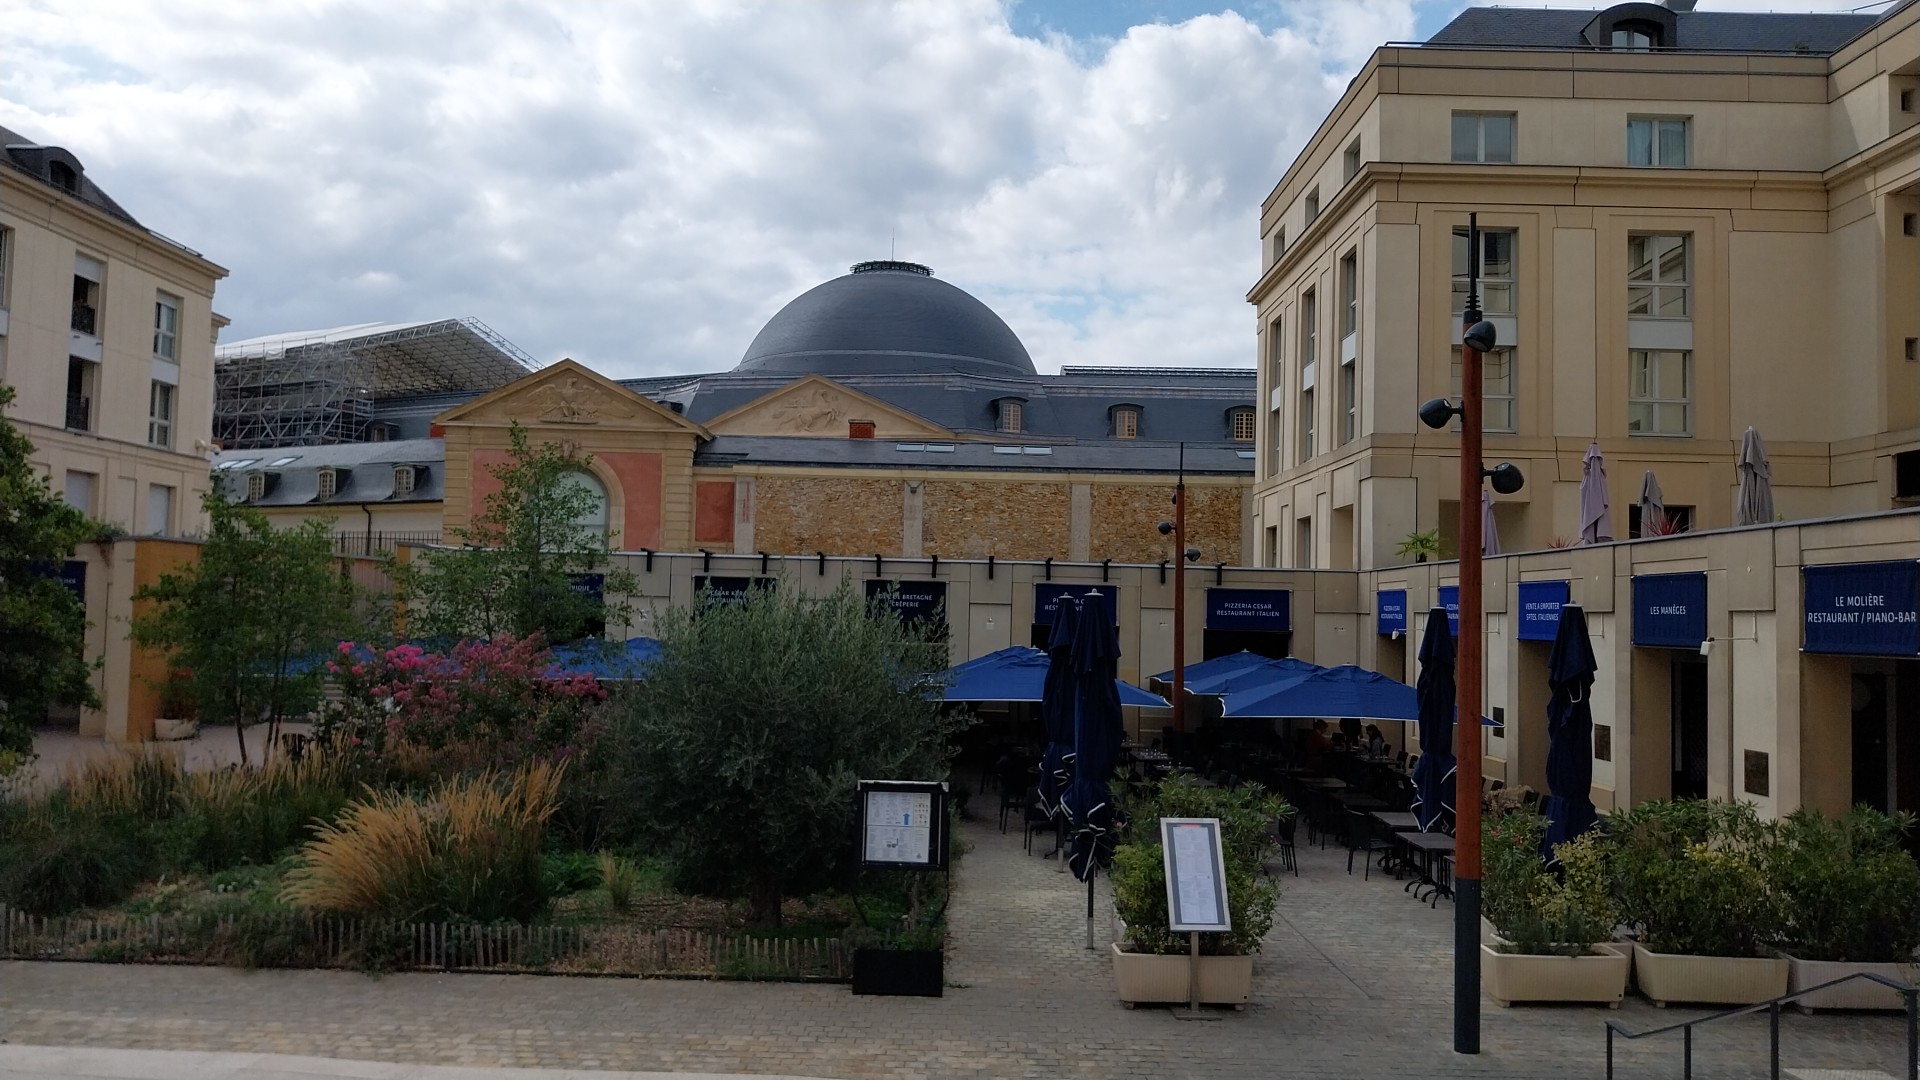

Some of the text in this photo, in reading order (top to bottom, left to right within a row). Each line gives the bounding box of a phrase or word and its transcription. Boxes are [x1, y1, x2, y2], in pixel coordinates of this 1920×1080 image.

[1835, 593, 1884, 607] LE MOLIÈRE
[1650, 603, 1686, 615] LES MANÈGES
[1807, 612, 1860, 623] RESTAURANT
[1866, 611, 1917, 623] PIANO-BAR
